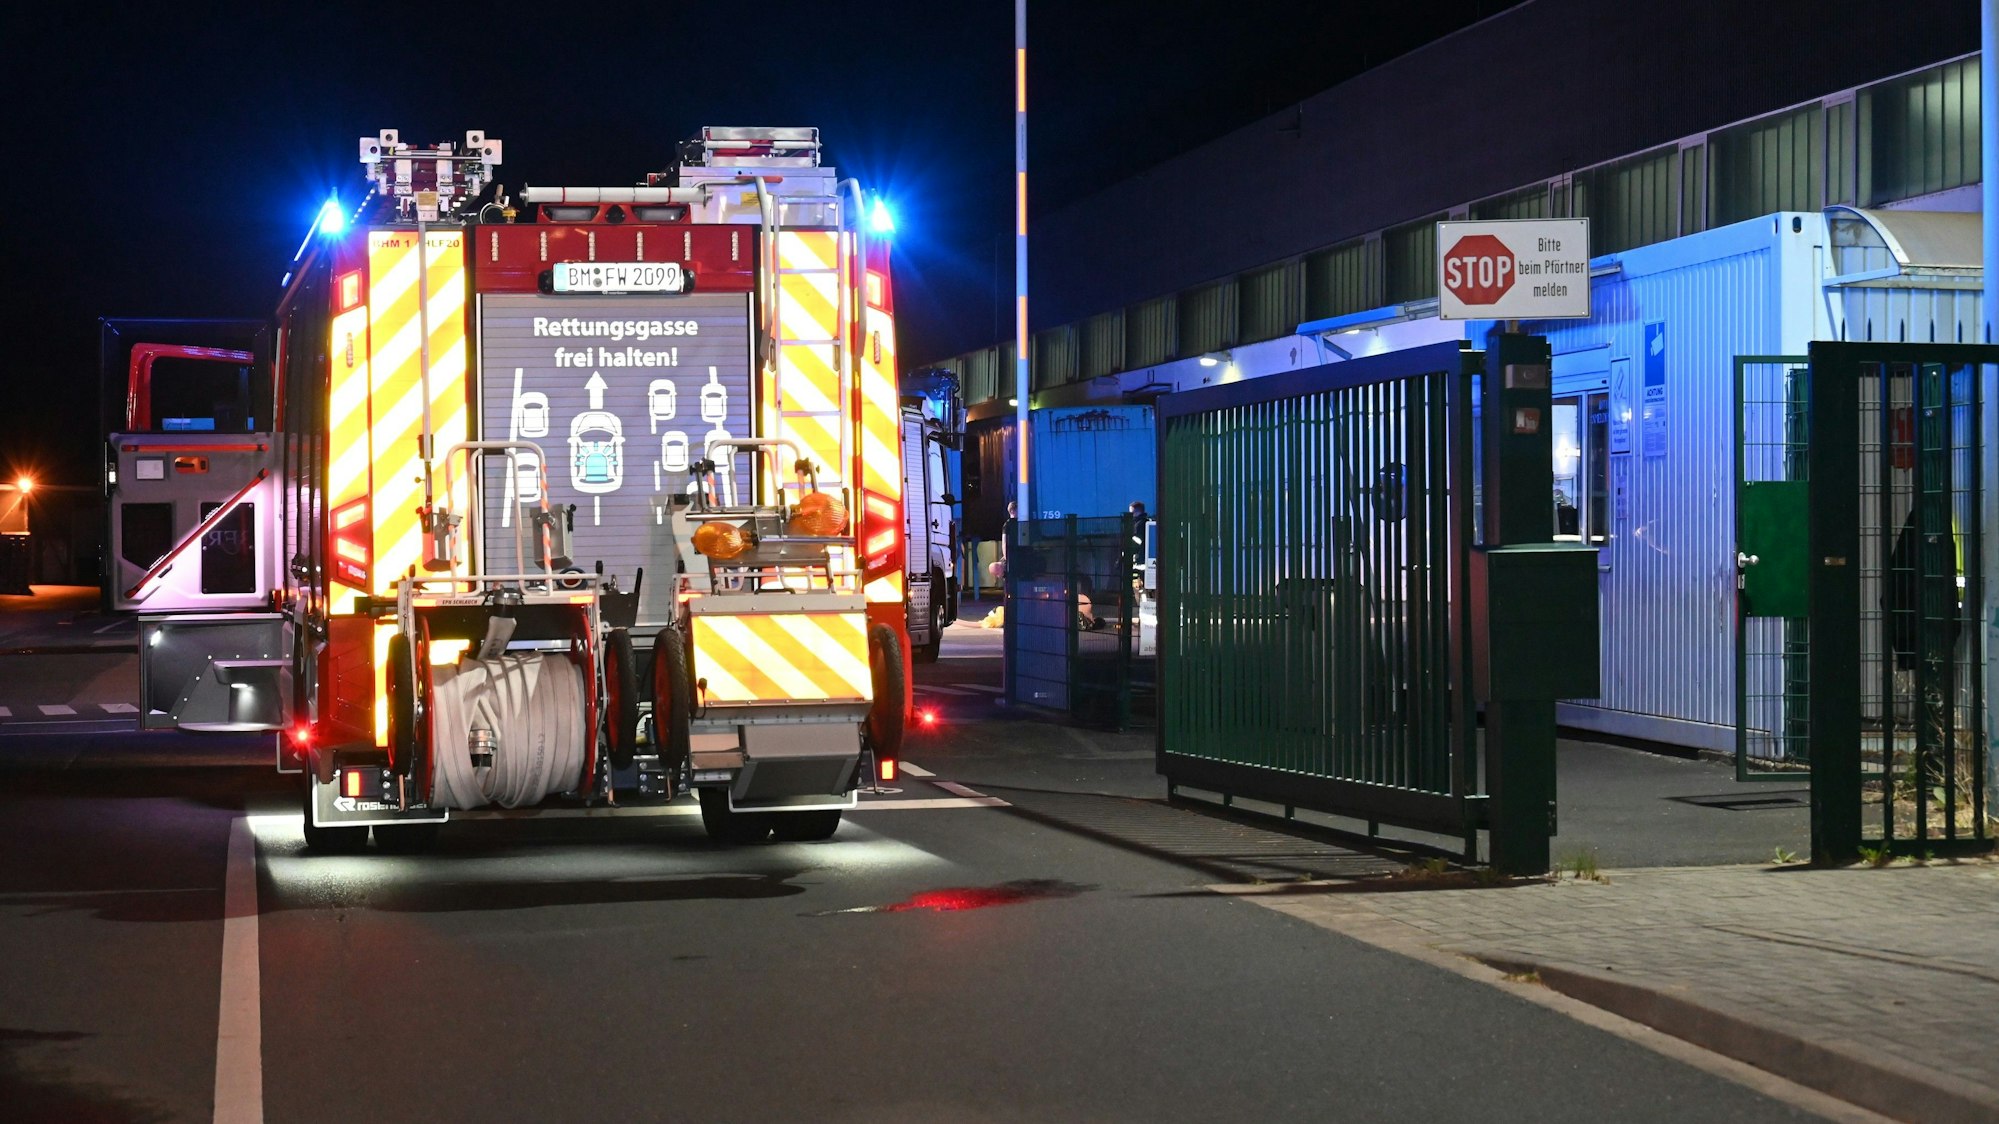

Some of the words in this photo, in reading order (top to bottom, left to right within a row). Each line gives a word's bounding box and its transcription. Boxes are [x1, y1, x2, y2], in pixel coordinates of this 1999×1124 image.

[1538, 237, 1561, 252] Bitte
[1447, 255, 1512, 289] STOP
[1518, 260, 1541, 275] beim
[1544, 259, 1585, 274] Pförtner
[569, 267, 591, 286] BM
[605, 267, 627, 286] FW
[633, 267, 676, 286] 2099
[1533, 282, 1567, 297] melden
[533, 316, 699, 341] Rettungsgasse
[554, 346, 594, 368] frei
[598, 346, 678, 368] halten!
[1042, 510, 1061, 519] 759
